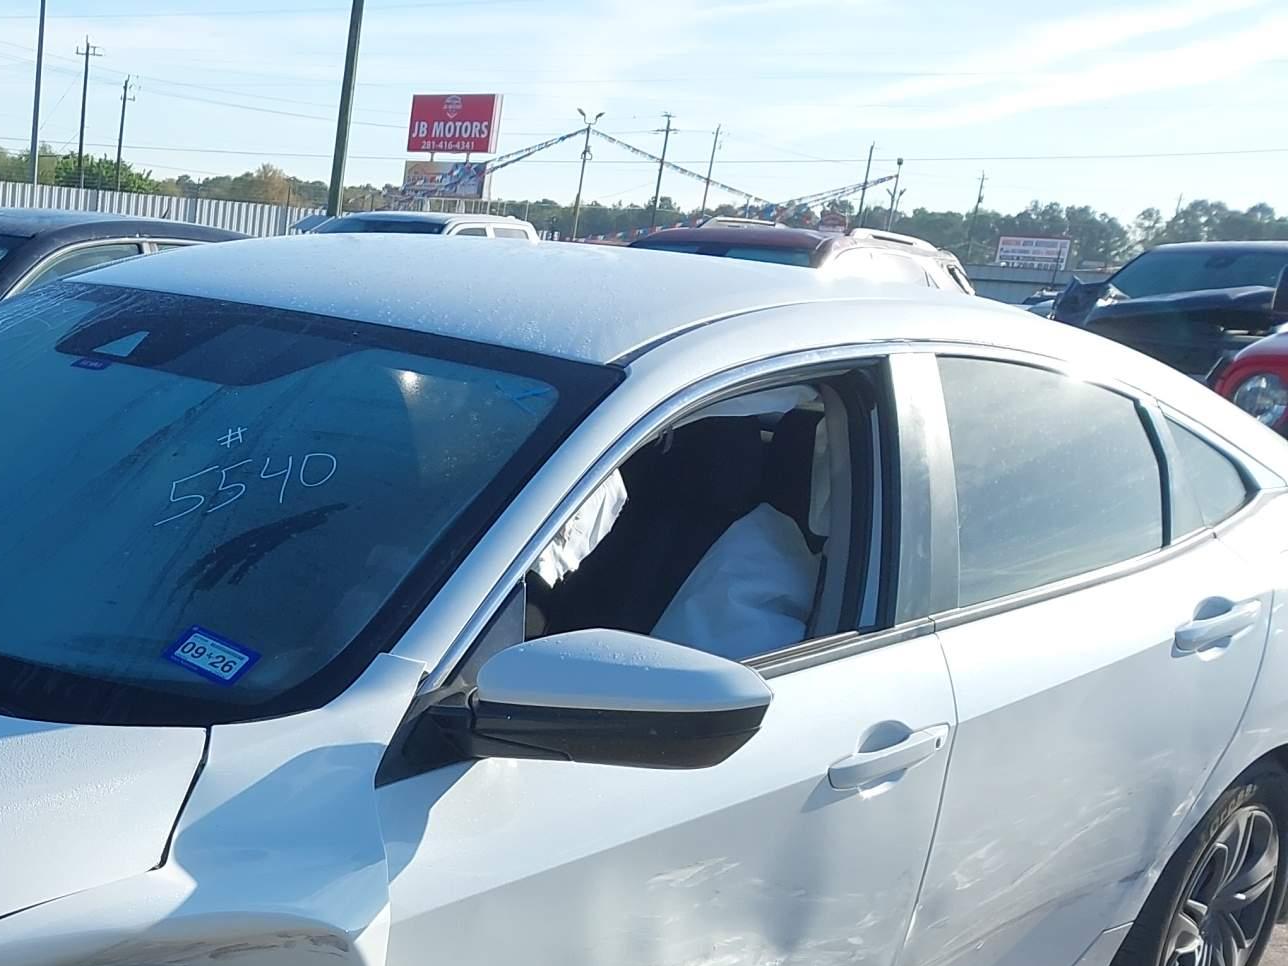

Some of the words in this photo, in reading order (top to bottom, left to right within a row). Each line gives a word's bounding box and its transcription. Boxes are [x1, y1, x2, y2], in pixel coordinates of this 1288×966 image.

[412, 121, 428, 138] JB
[431, 121, 489, 138] MOTORS
[216, 426, 248, 449] #
[153, 452, 338, 527] 5540
[180, 641, 207, 659] 09
[208, 655, 237, 673] 26
